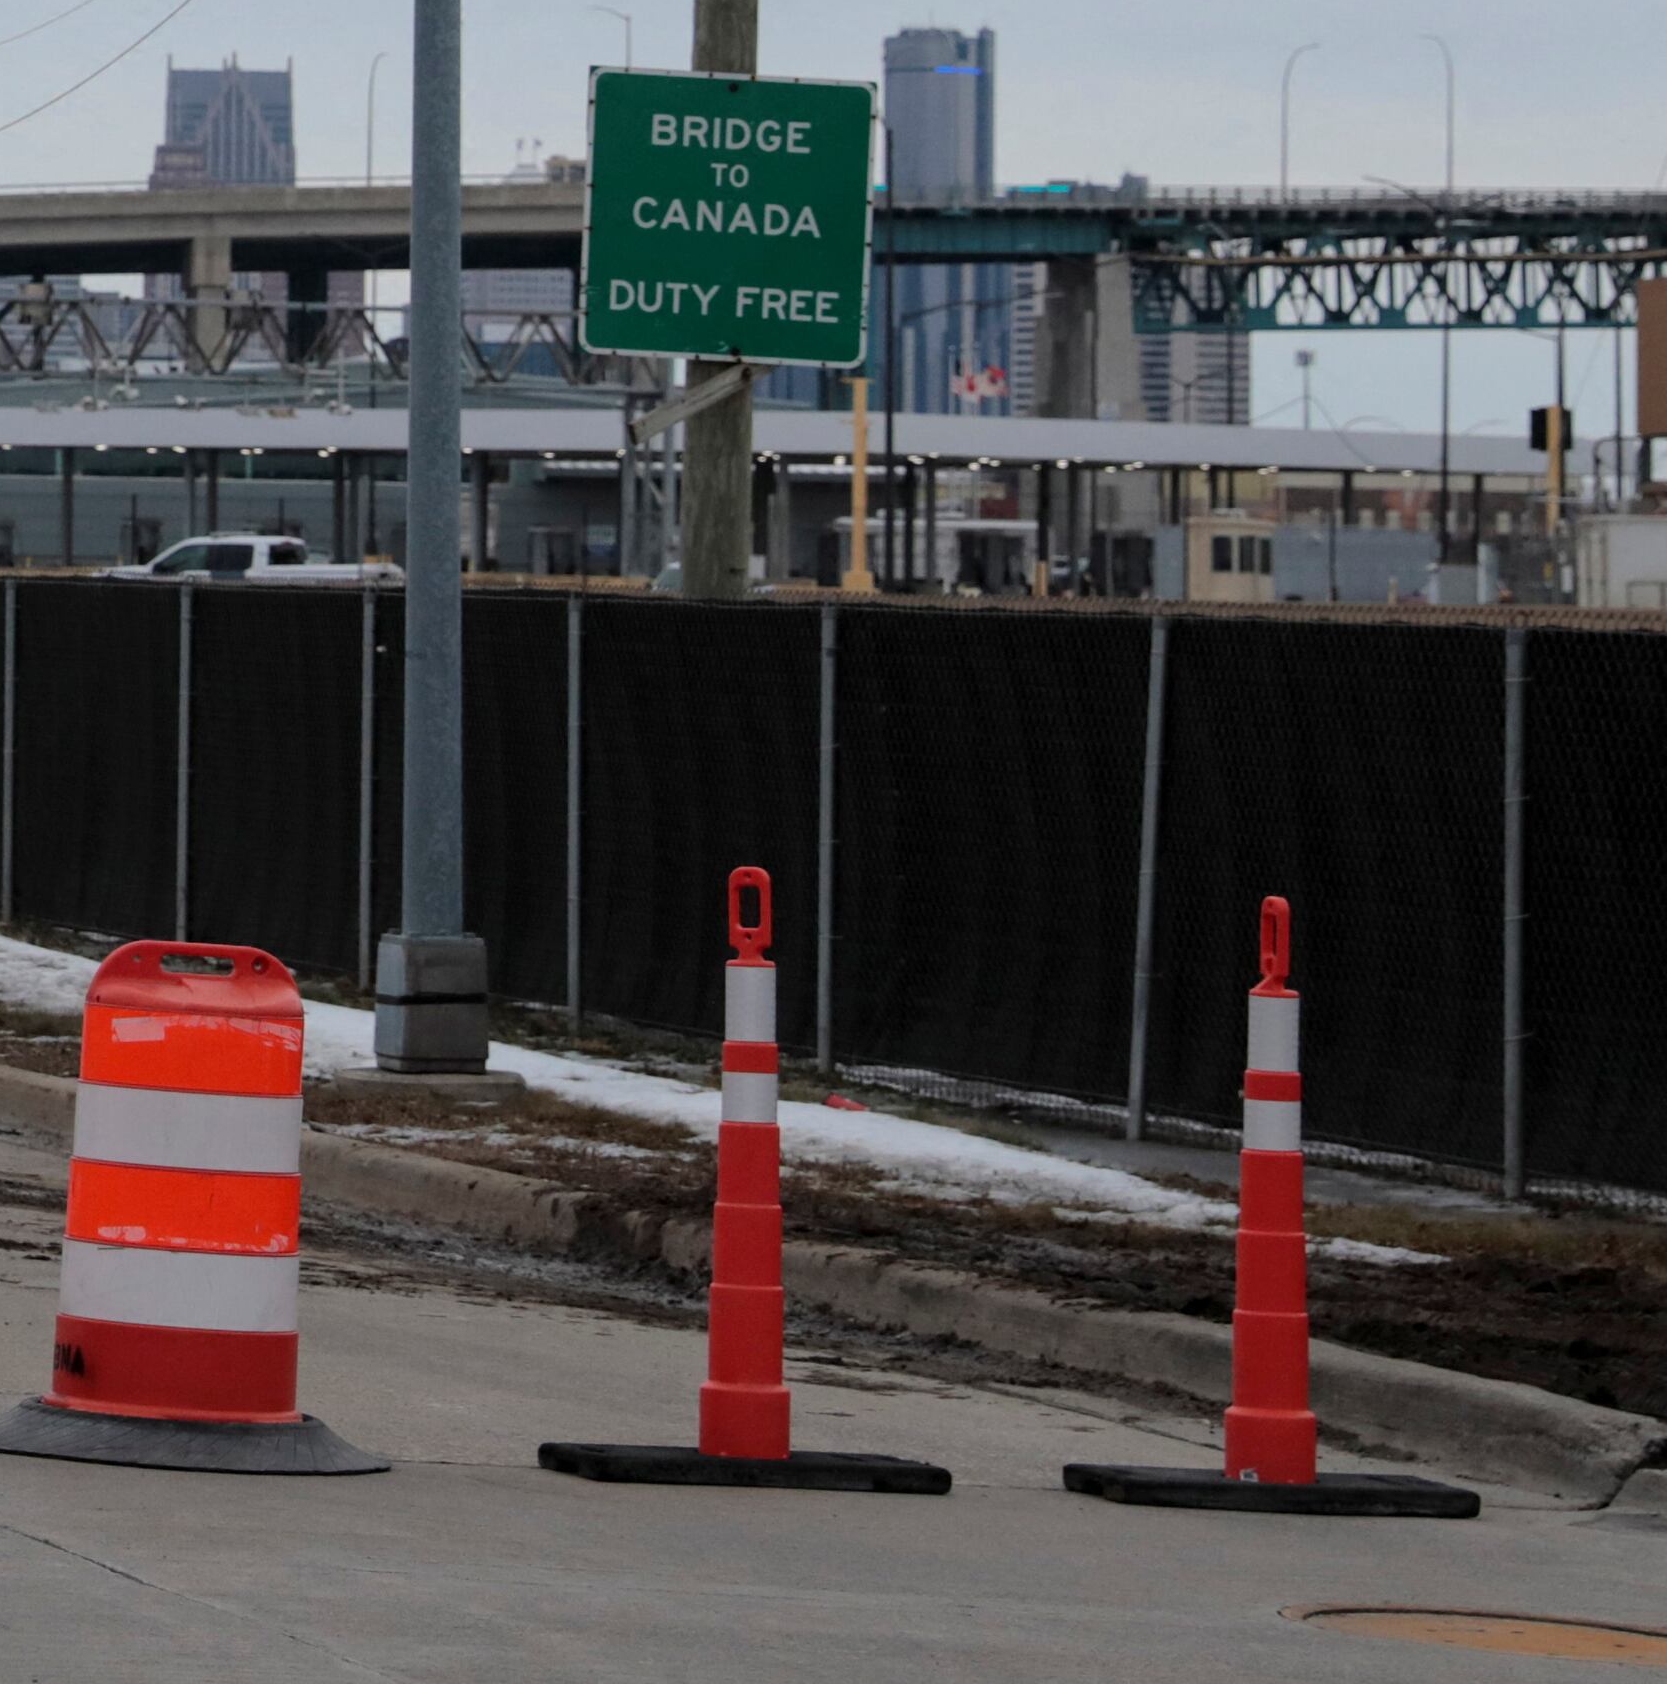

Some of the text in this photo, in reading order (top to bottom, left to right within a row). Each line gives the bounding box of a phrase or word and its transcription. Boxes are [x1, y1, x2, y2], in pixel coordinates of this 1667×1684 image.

[650, 112, 813, 155] BRIDGE
[710, 162, 750, 188] TO
[631, 195, 822, 239] CANADA
[608, 279, 841, 325] DUTY FREE
